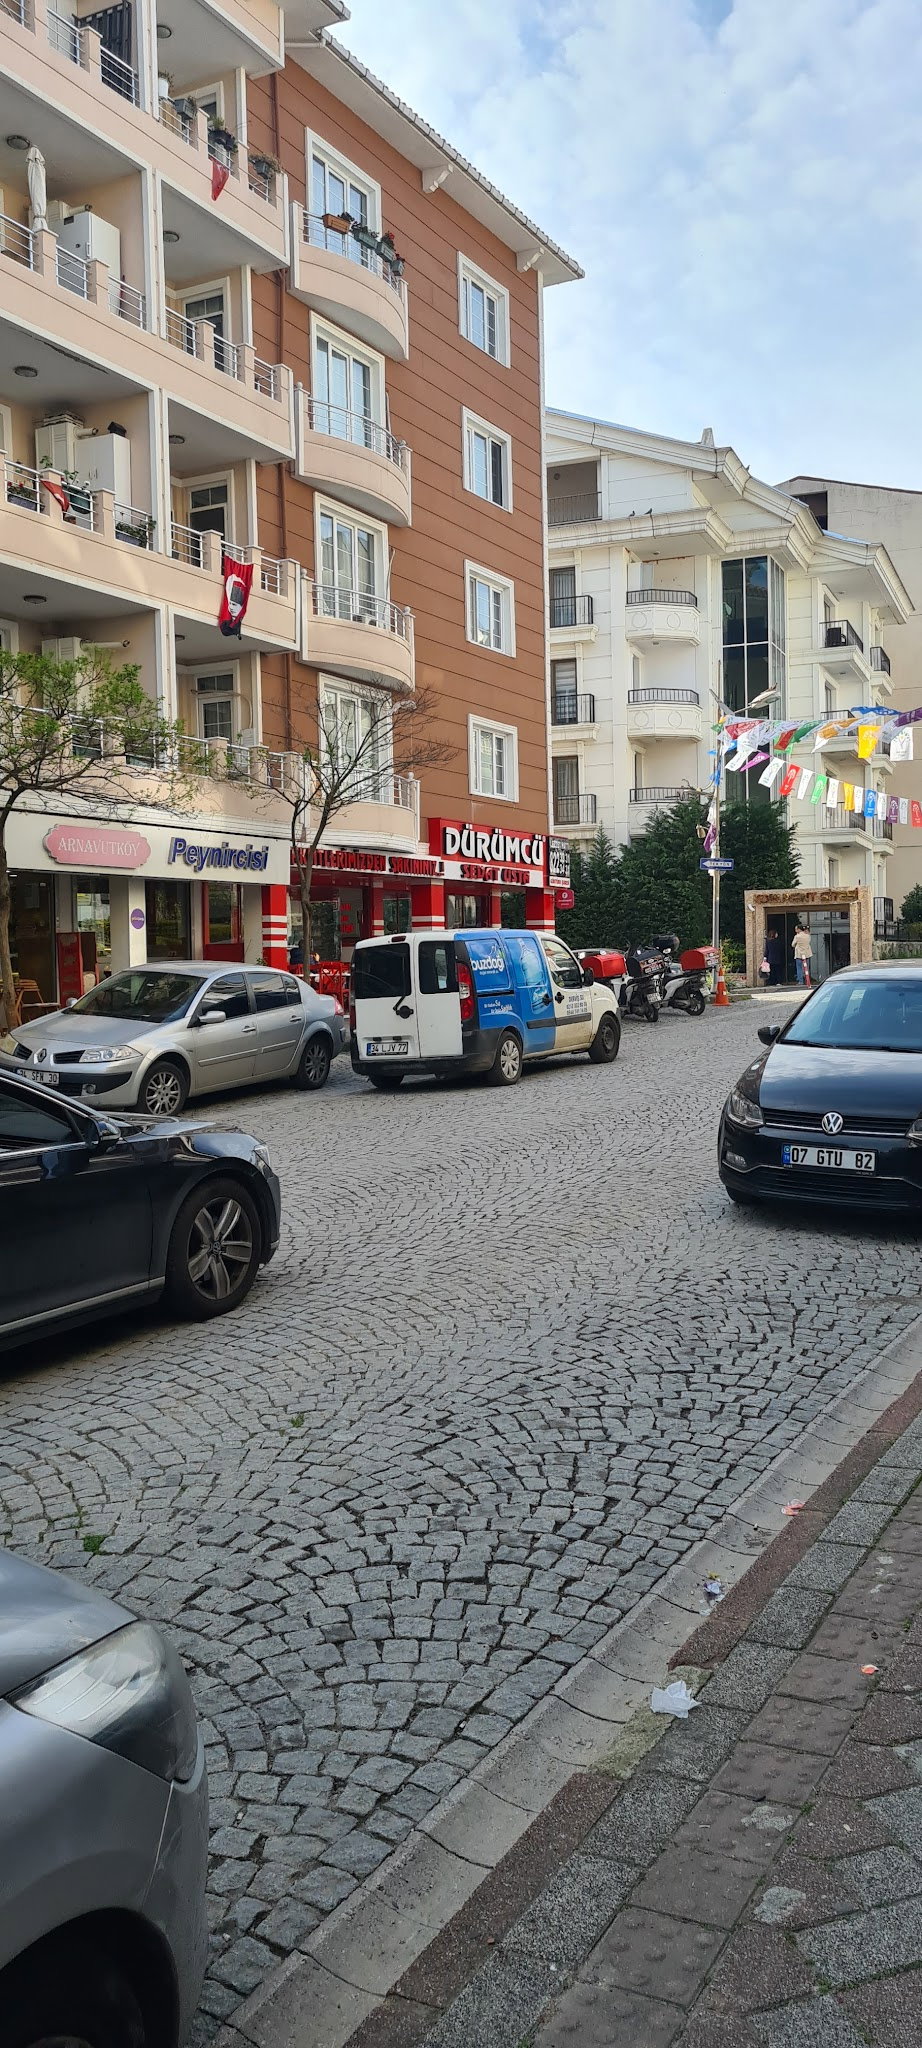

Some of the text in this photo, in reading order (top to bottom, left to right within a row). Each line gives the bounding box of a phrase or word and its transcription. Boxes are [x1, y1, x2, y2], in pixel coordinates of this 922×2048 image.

[58, 837, 140, 857] ARNAVUTKÖY
[168, 837, 269, 872] Peynircisi
[445, 823, 544, 866] DÜRÜMCÜ
[461, 863, 530, 885] SEDAT USTA
[398, 1043, 407, 1051] 77
[48, 1073, 58, 1082] 30
[791, 1147, 873, 1169] 07 GTU 82
